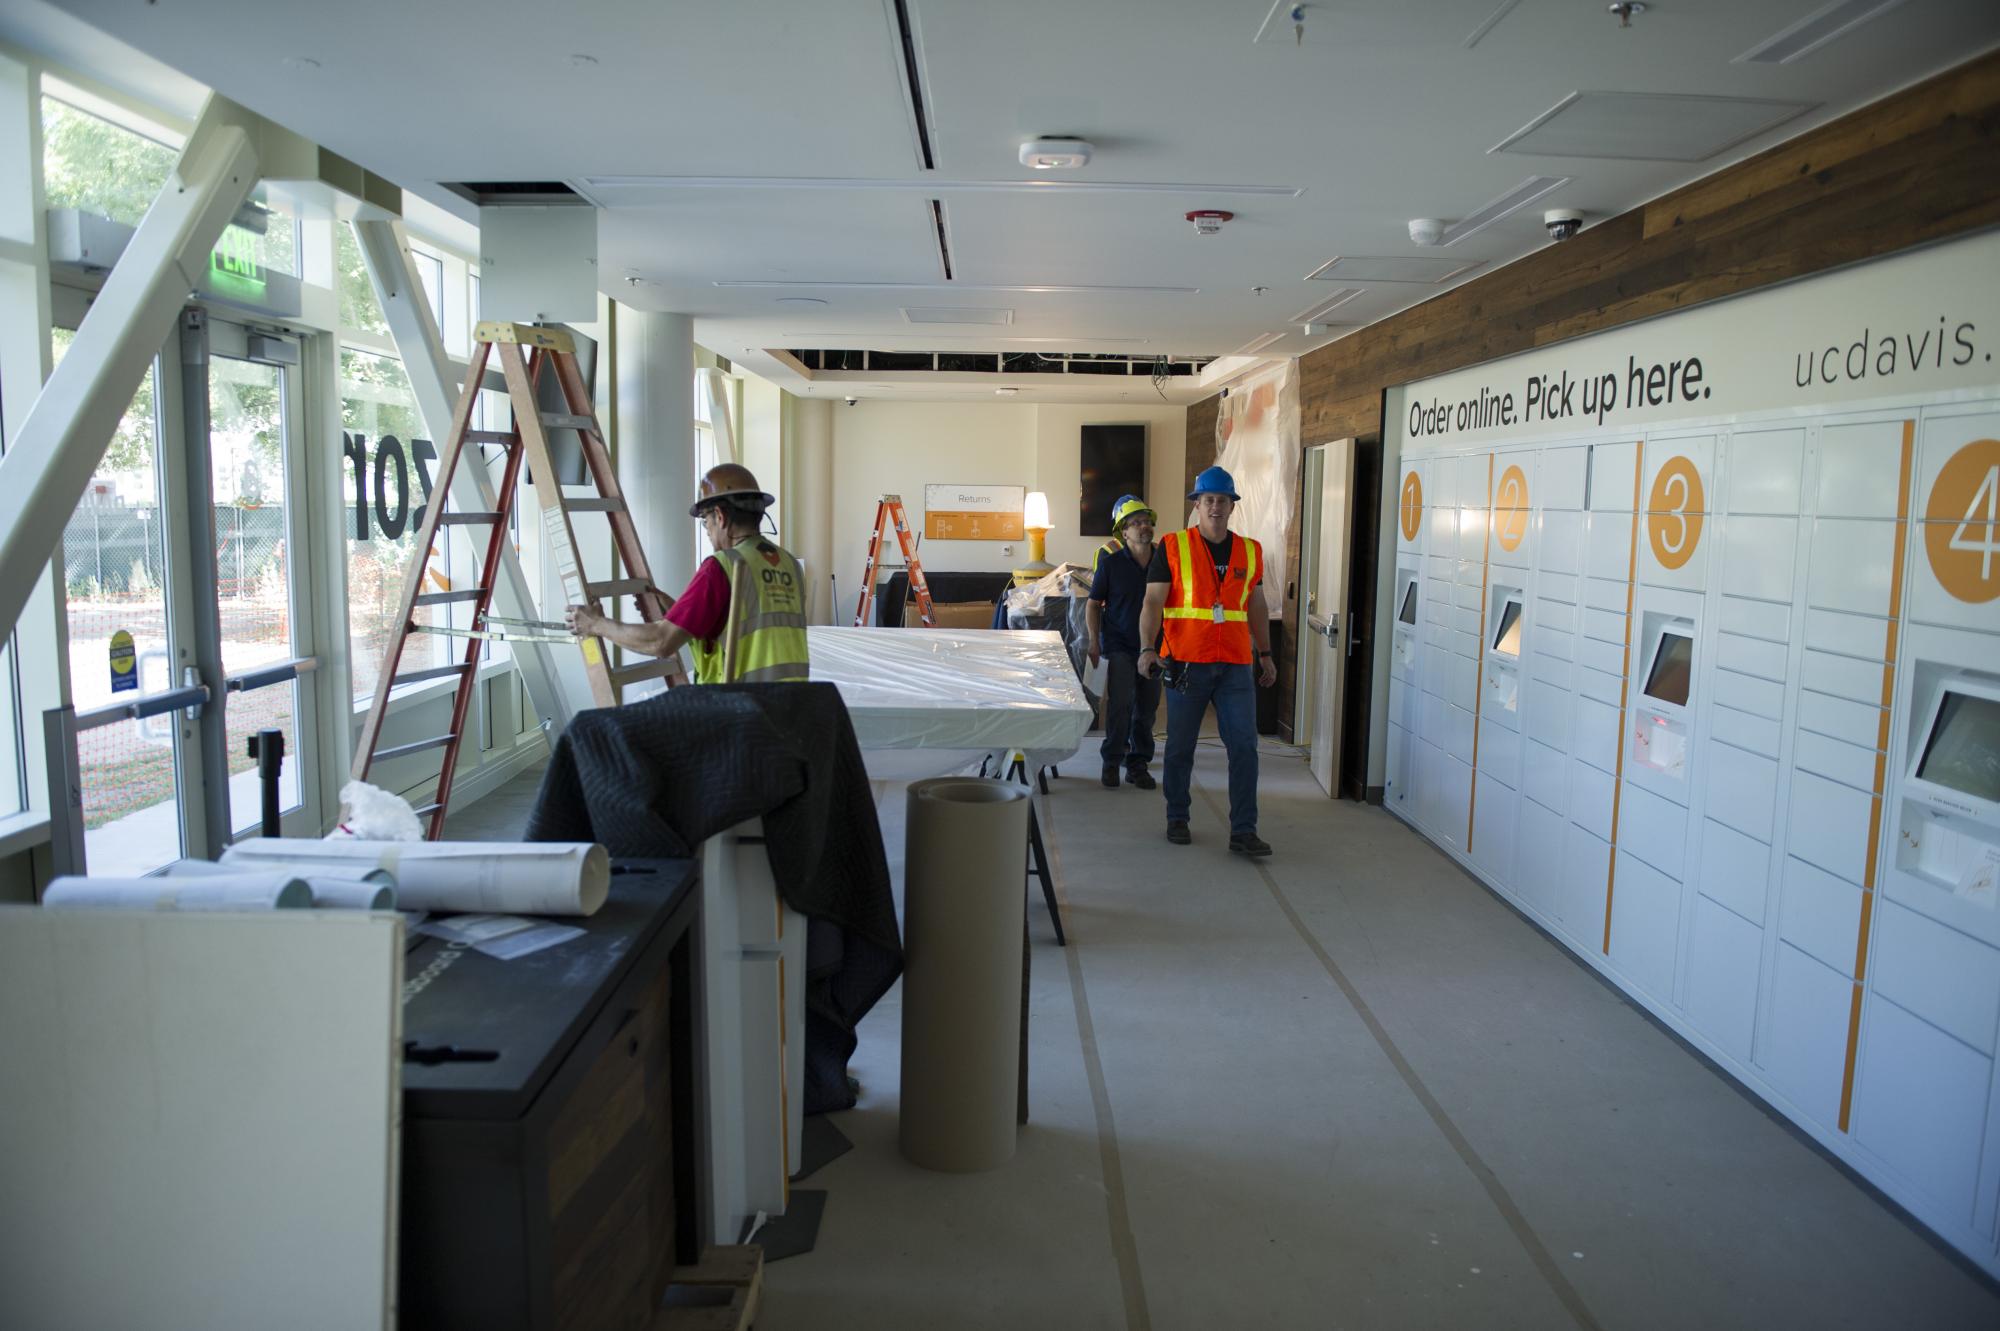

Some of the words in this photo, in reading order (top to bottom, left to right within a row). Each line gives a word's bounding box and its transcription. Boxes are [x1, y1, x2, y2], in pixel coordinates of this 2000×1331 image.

[222, 225, 257, 278] EXIT
[1409, 397, 1454, 438] Order
[1457, 386, 1518, 432] online.
[1525, 370, 1576, 422] Pick
[1582, 372, 1617, 426] up
[1626, 355, 1711, 409] here.
[958, 494, 992, 504] Returns
[1407, 482, 1415, 532] 1
[1504, 478, 1520, 540] 2
[1661, 472, 1689, 554] 3
[1949, 464, 2000, 581] 4
